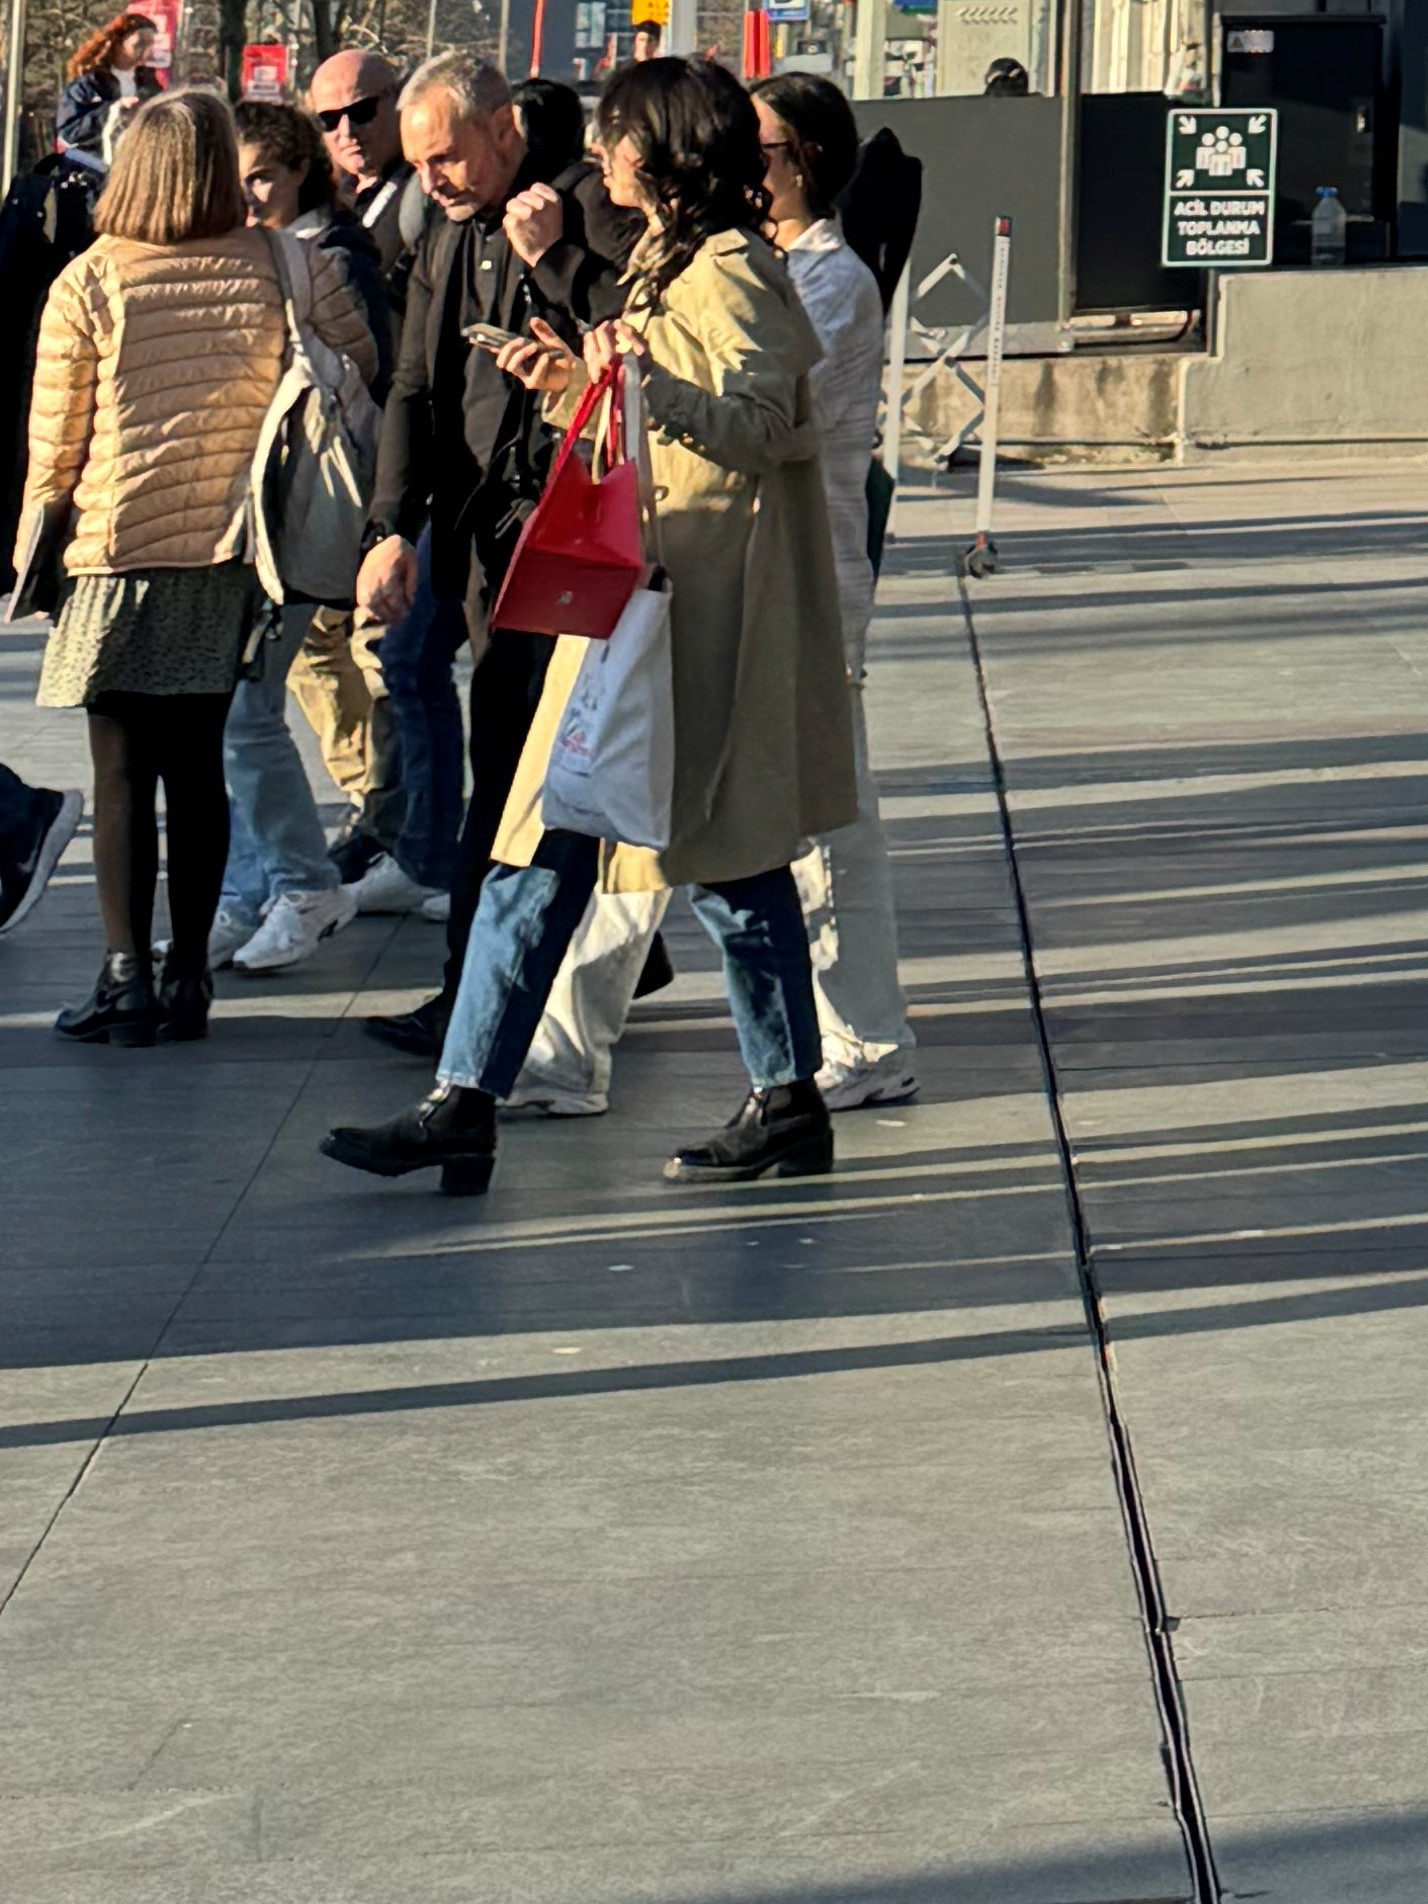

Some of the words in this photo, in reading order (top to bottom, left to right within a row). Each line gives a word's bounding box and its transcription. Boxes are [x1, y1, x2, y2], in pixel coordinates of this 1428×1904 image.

[1174, 199, 1208, 216] ACİL
[1210, 201, 1265, 216] DURUM
[1177, 220, 1261, 236] TOPLANMA
[1186, 238, 1250, 255] BÖLGESİ
